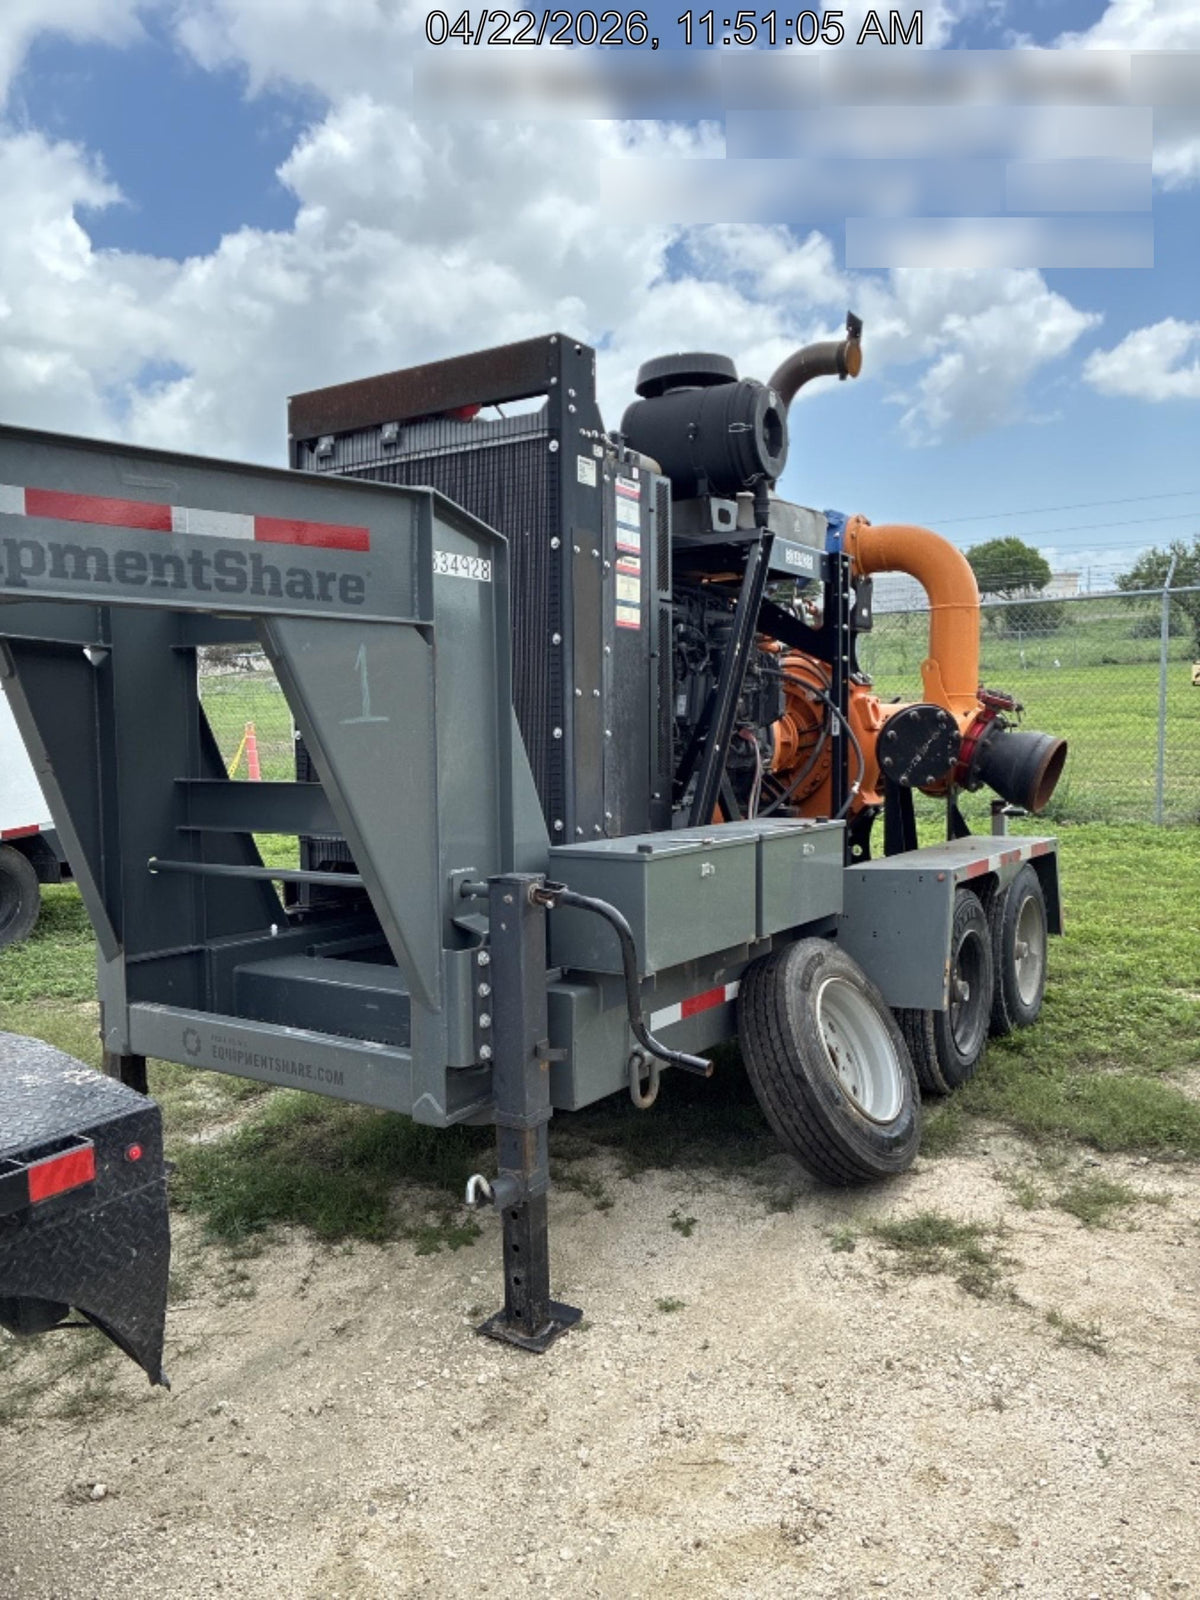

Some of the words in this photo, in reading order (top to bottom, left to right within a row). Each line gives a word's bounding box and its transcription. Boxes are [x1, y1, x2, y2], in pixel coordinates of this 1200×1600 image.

[0, 538, 365, 605] pmentShare
[338, 643, 390, 725] 1
[212, 1044, 345, 1086] EQUIPMENTSHARE.COM
